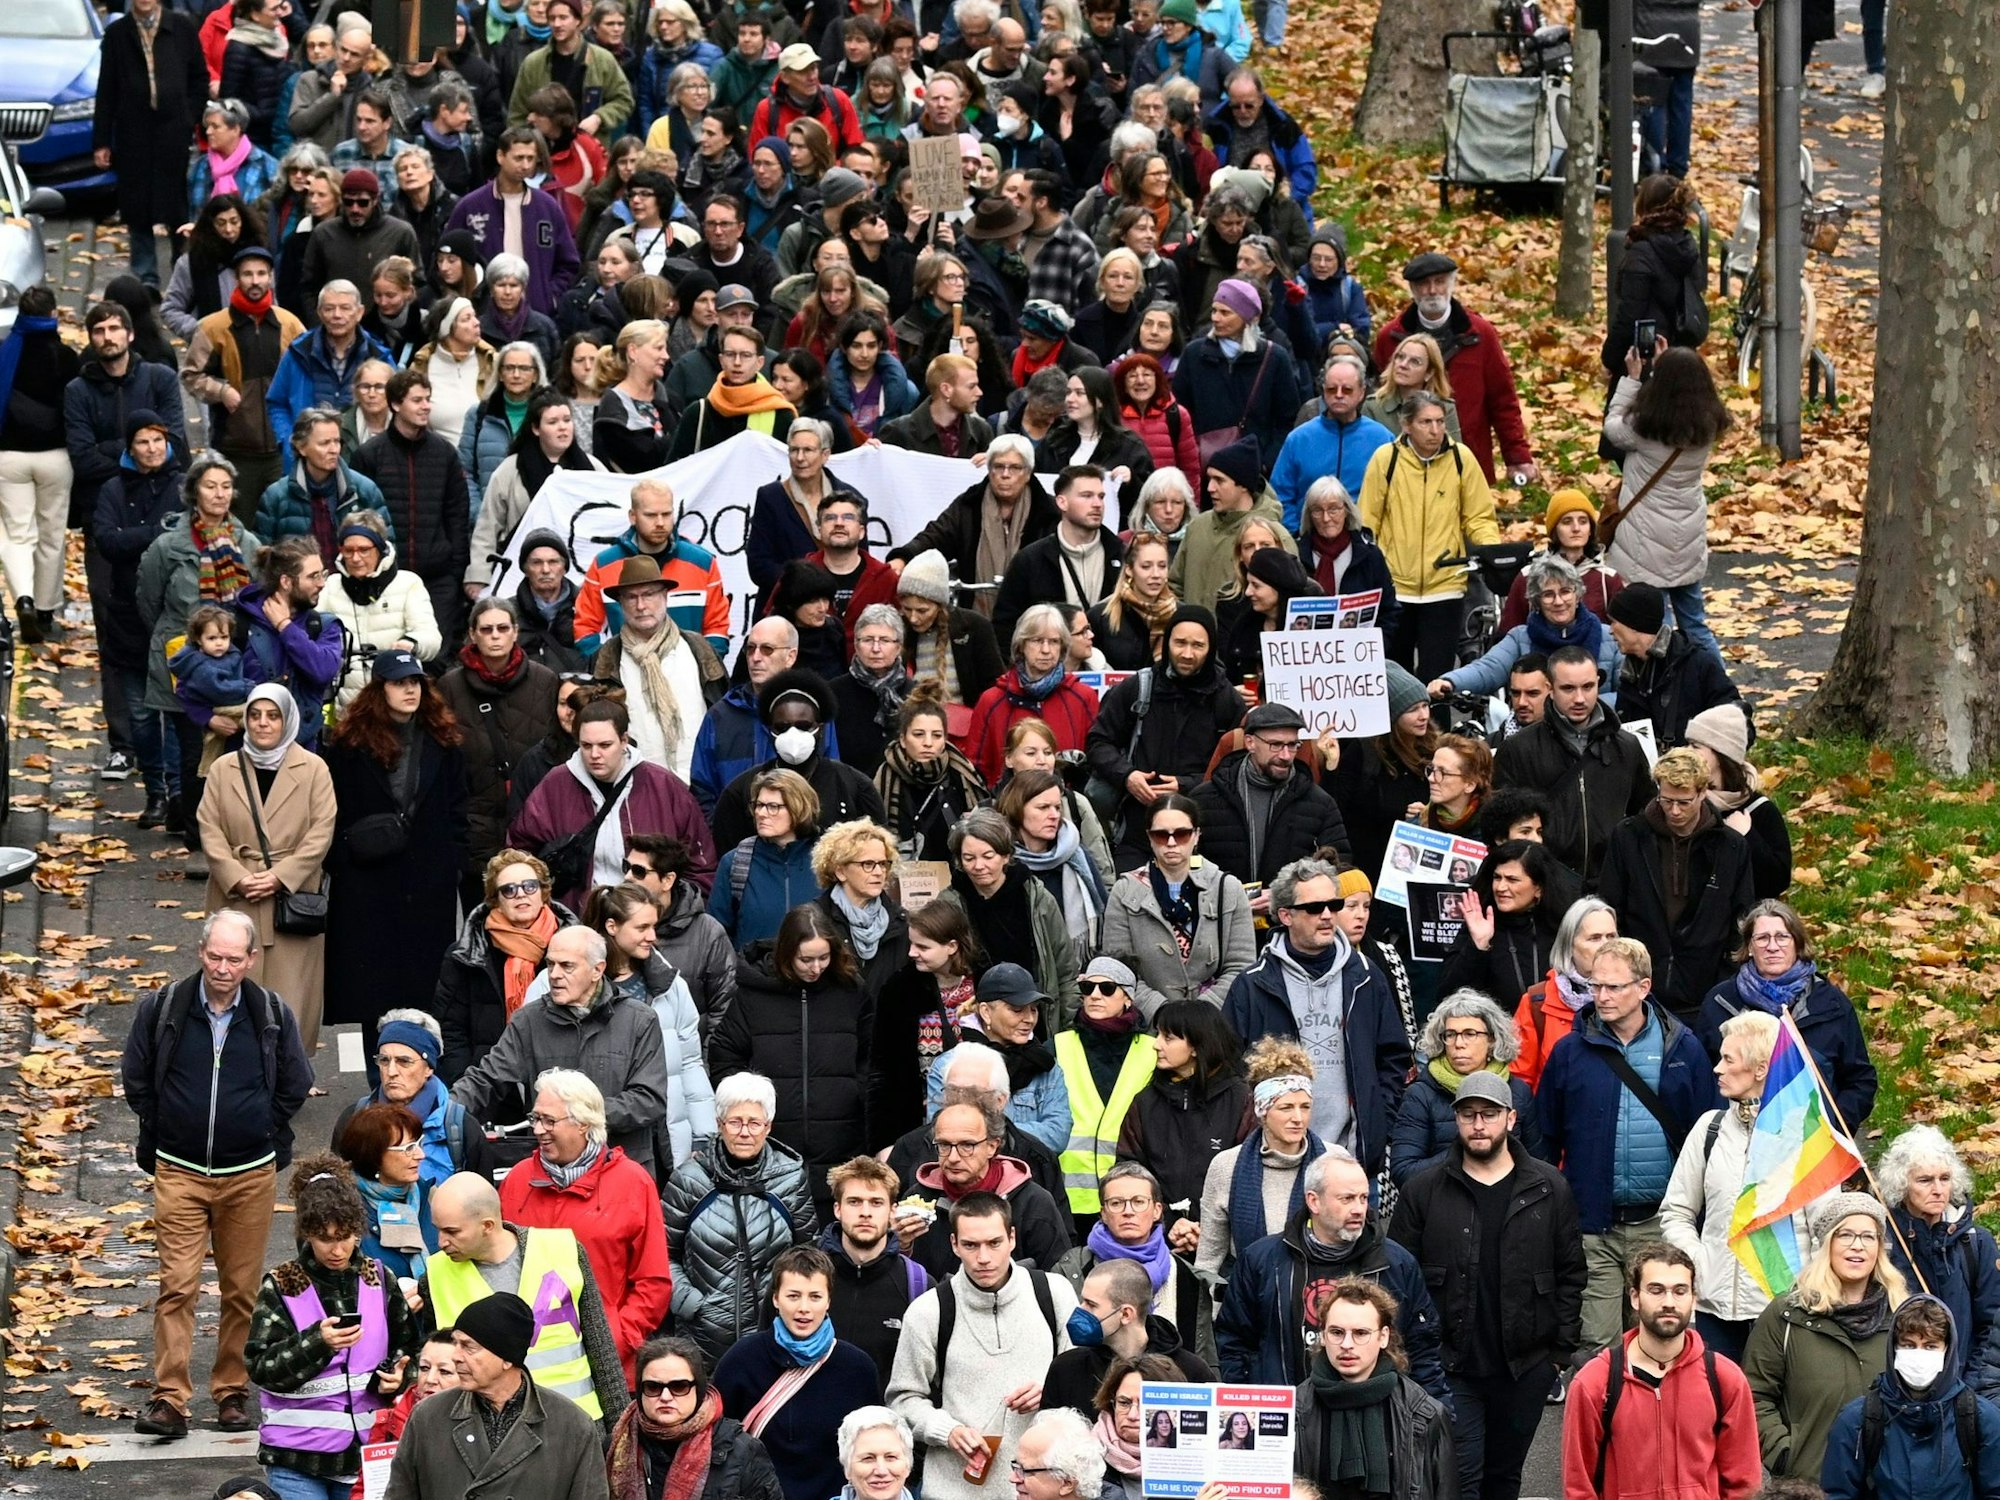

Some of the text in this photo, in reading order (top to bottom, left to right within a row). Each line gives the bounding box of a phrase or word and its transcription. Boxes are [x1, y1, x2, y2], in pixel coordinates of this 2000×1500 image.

[913, 139, 956, 169] LOVE
[537, 220, 553, 247] C
[1267, 640, 1378, 667] RELEASE OF
[1267, 674, 1385, 702] THE HOSTAGES
[1300, 708, 1357, 733] NOW
[1421, 928, 1435, 936] WE
[1422, 921, 1436, 929] WE
[1421, 935, 1455, 944] WE DES
[1297, 1013, 1343, 1030] USTAN
[530, 1270, 580, 1347] A
[371, 1449, 388, 1458] OUT
[1148, 1483, 1201, 1493] TEAR ME DOW
[1242, 1486, 1262, 1494] FIND
[1263, 1487, 1282, 1495] OUT
